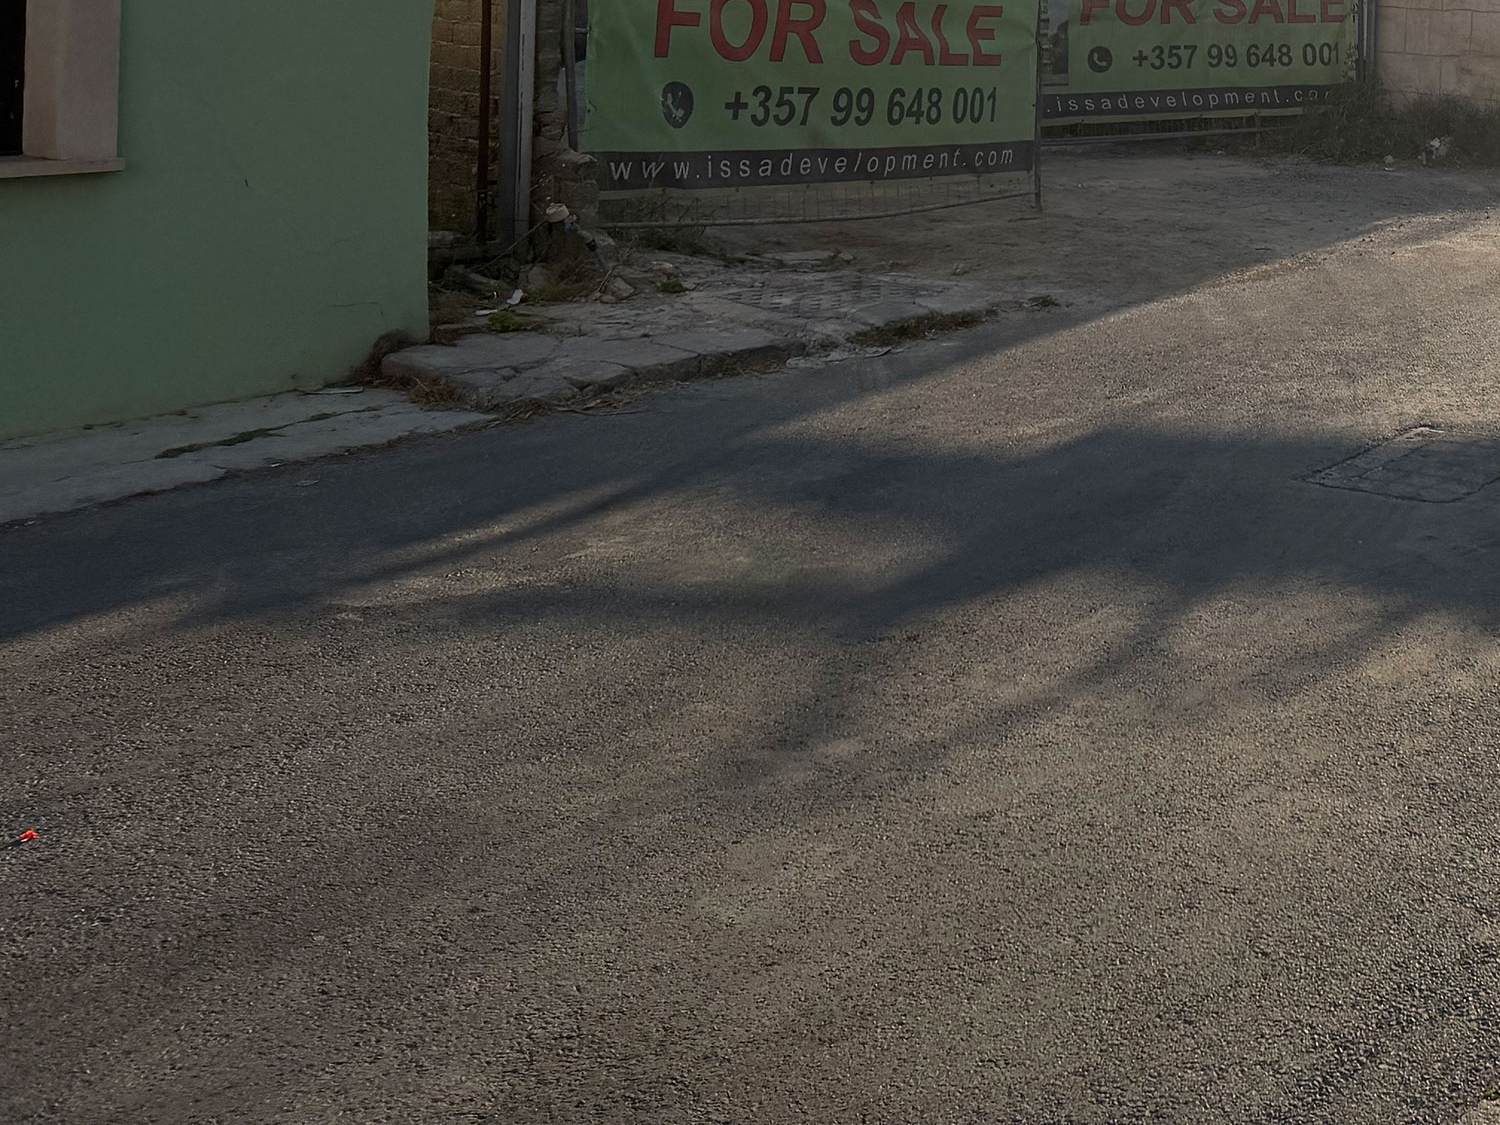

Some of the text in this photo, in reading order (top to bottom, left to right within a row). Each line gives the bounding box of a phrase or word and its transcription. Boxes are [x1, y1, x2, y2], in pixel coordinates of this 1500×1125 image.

[1132, 42, 1340, 69] +357 99 648 001
[724, 85, 997, 127] +357 99 648 001
[610, 146, 1015, 181] www.issadevelopment.com
